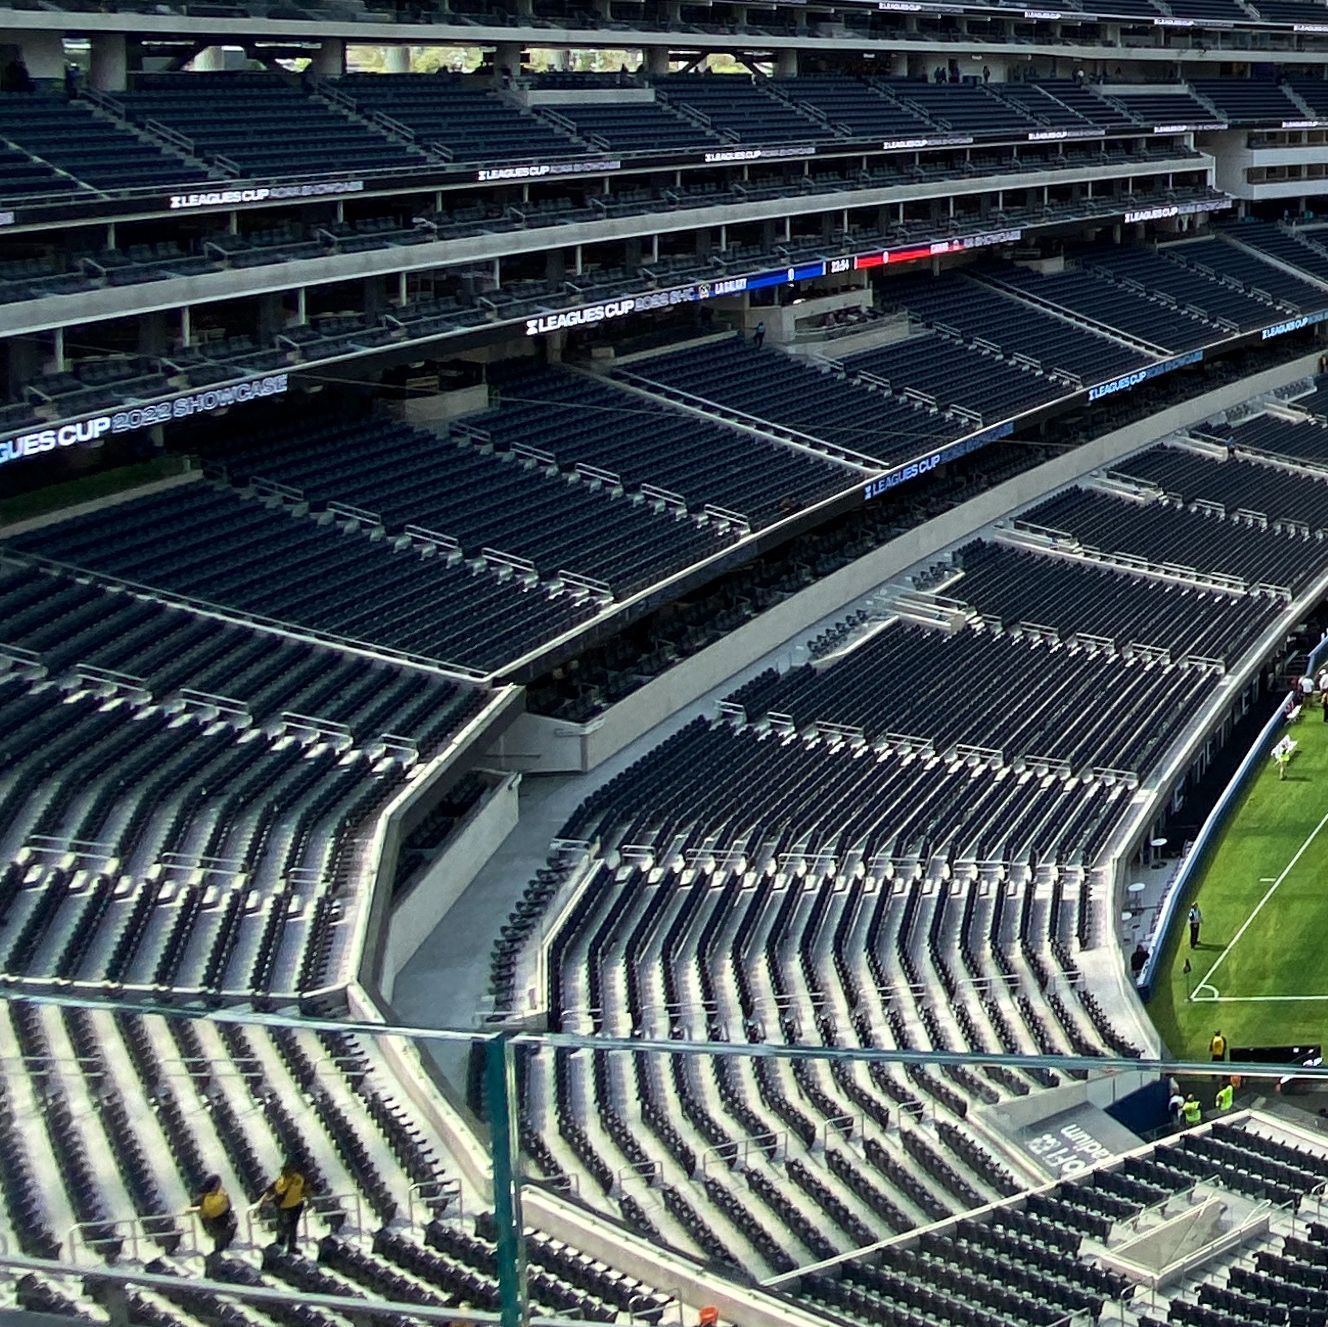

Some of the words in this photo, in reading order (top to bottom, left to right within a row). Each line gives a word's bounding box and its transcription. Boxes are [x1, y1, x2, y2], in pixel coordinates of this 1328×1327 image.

[240, 189, 269, 202] CUP
[539, 306, 604, 332] LEAGUES
[605, 300, 635, 318] CUP
[57, 417, 111, 447] CUP
[111, 402, 172, 433] 2022
[173, 374, 288, 418] SHOWCASE
[873, 464, 918, 496] LEAGUES
[919, 454, 940, 474] CUP
[1041, 1147, 1086, 1176] oFi
